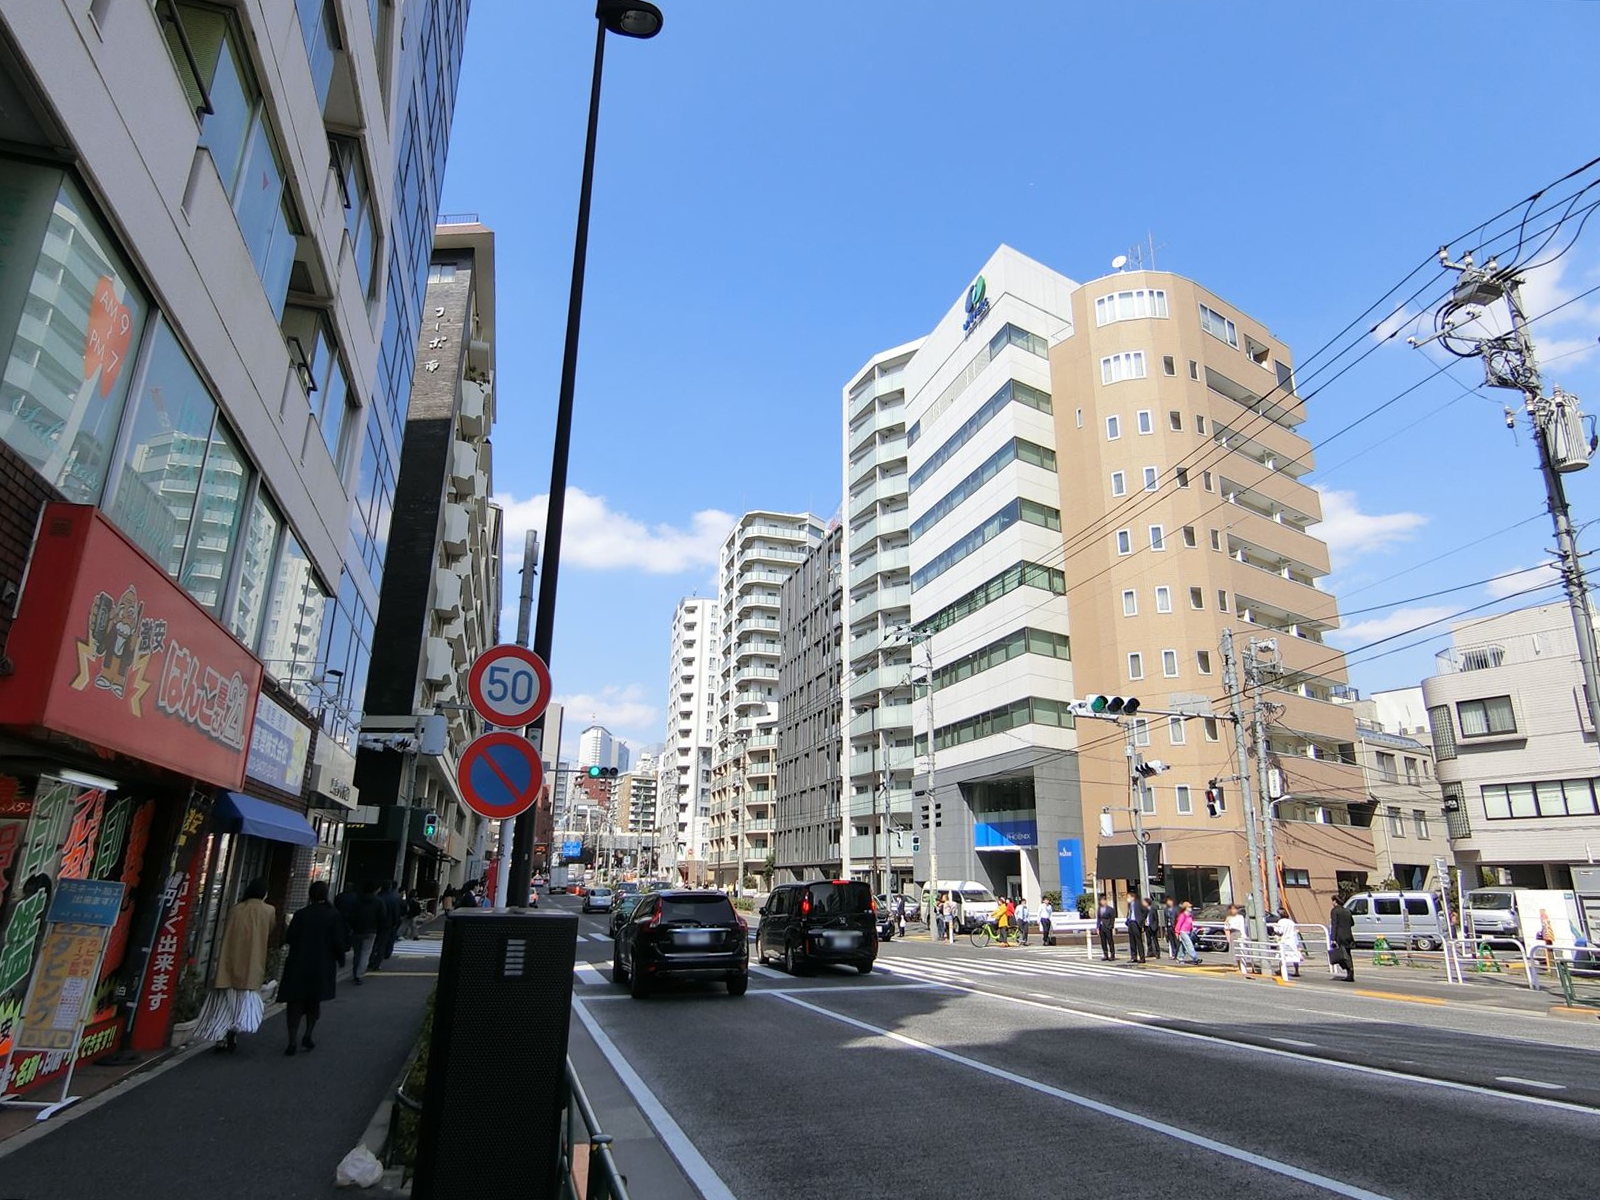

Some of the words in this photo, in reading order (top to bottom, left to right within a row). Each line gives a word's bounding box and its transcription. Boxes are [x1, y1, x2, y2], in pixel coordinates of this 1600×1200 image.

[100, 291, 119, 322] AM
[120, 314, 130, 336] 9
[89, 330, 106, 360] PM
[107, 350, 119, 373] 7
[139, 618, 168, 654] 激安
[158, 638, 249, 752] はんこ屋21
[487, 665, 534, 706] 50
